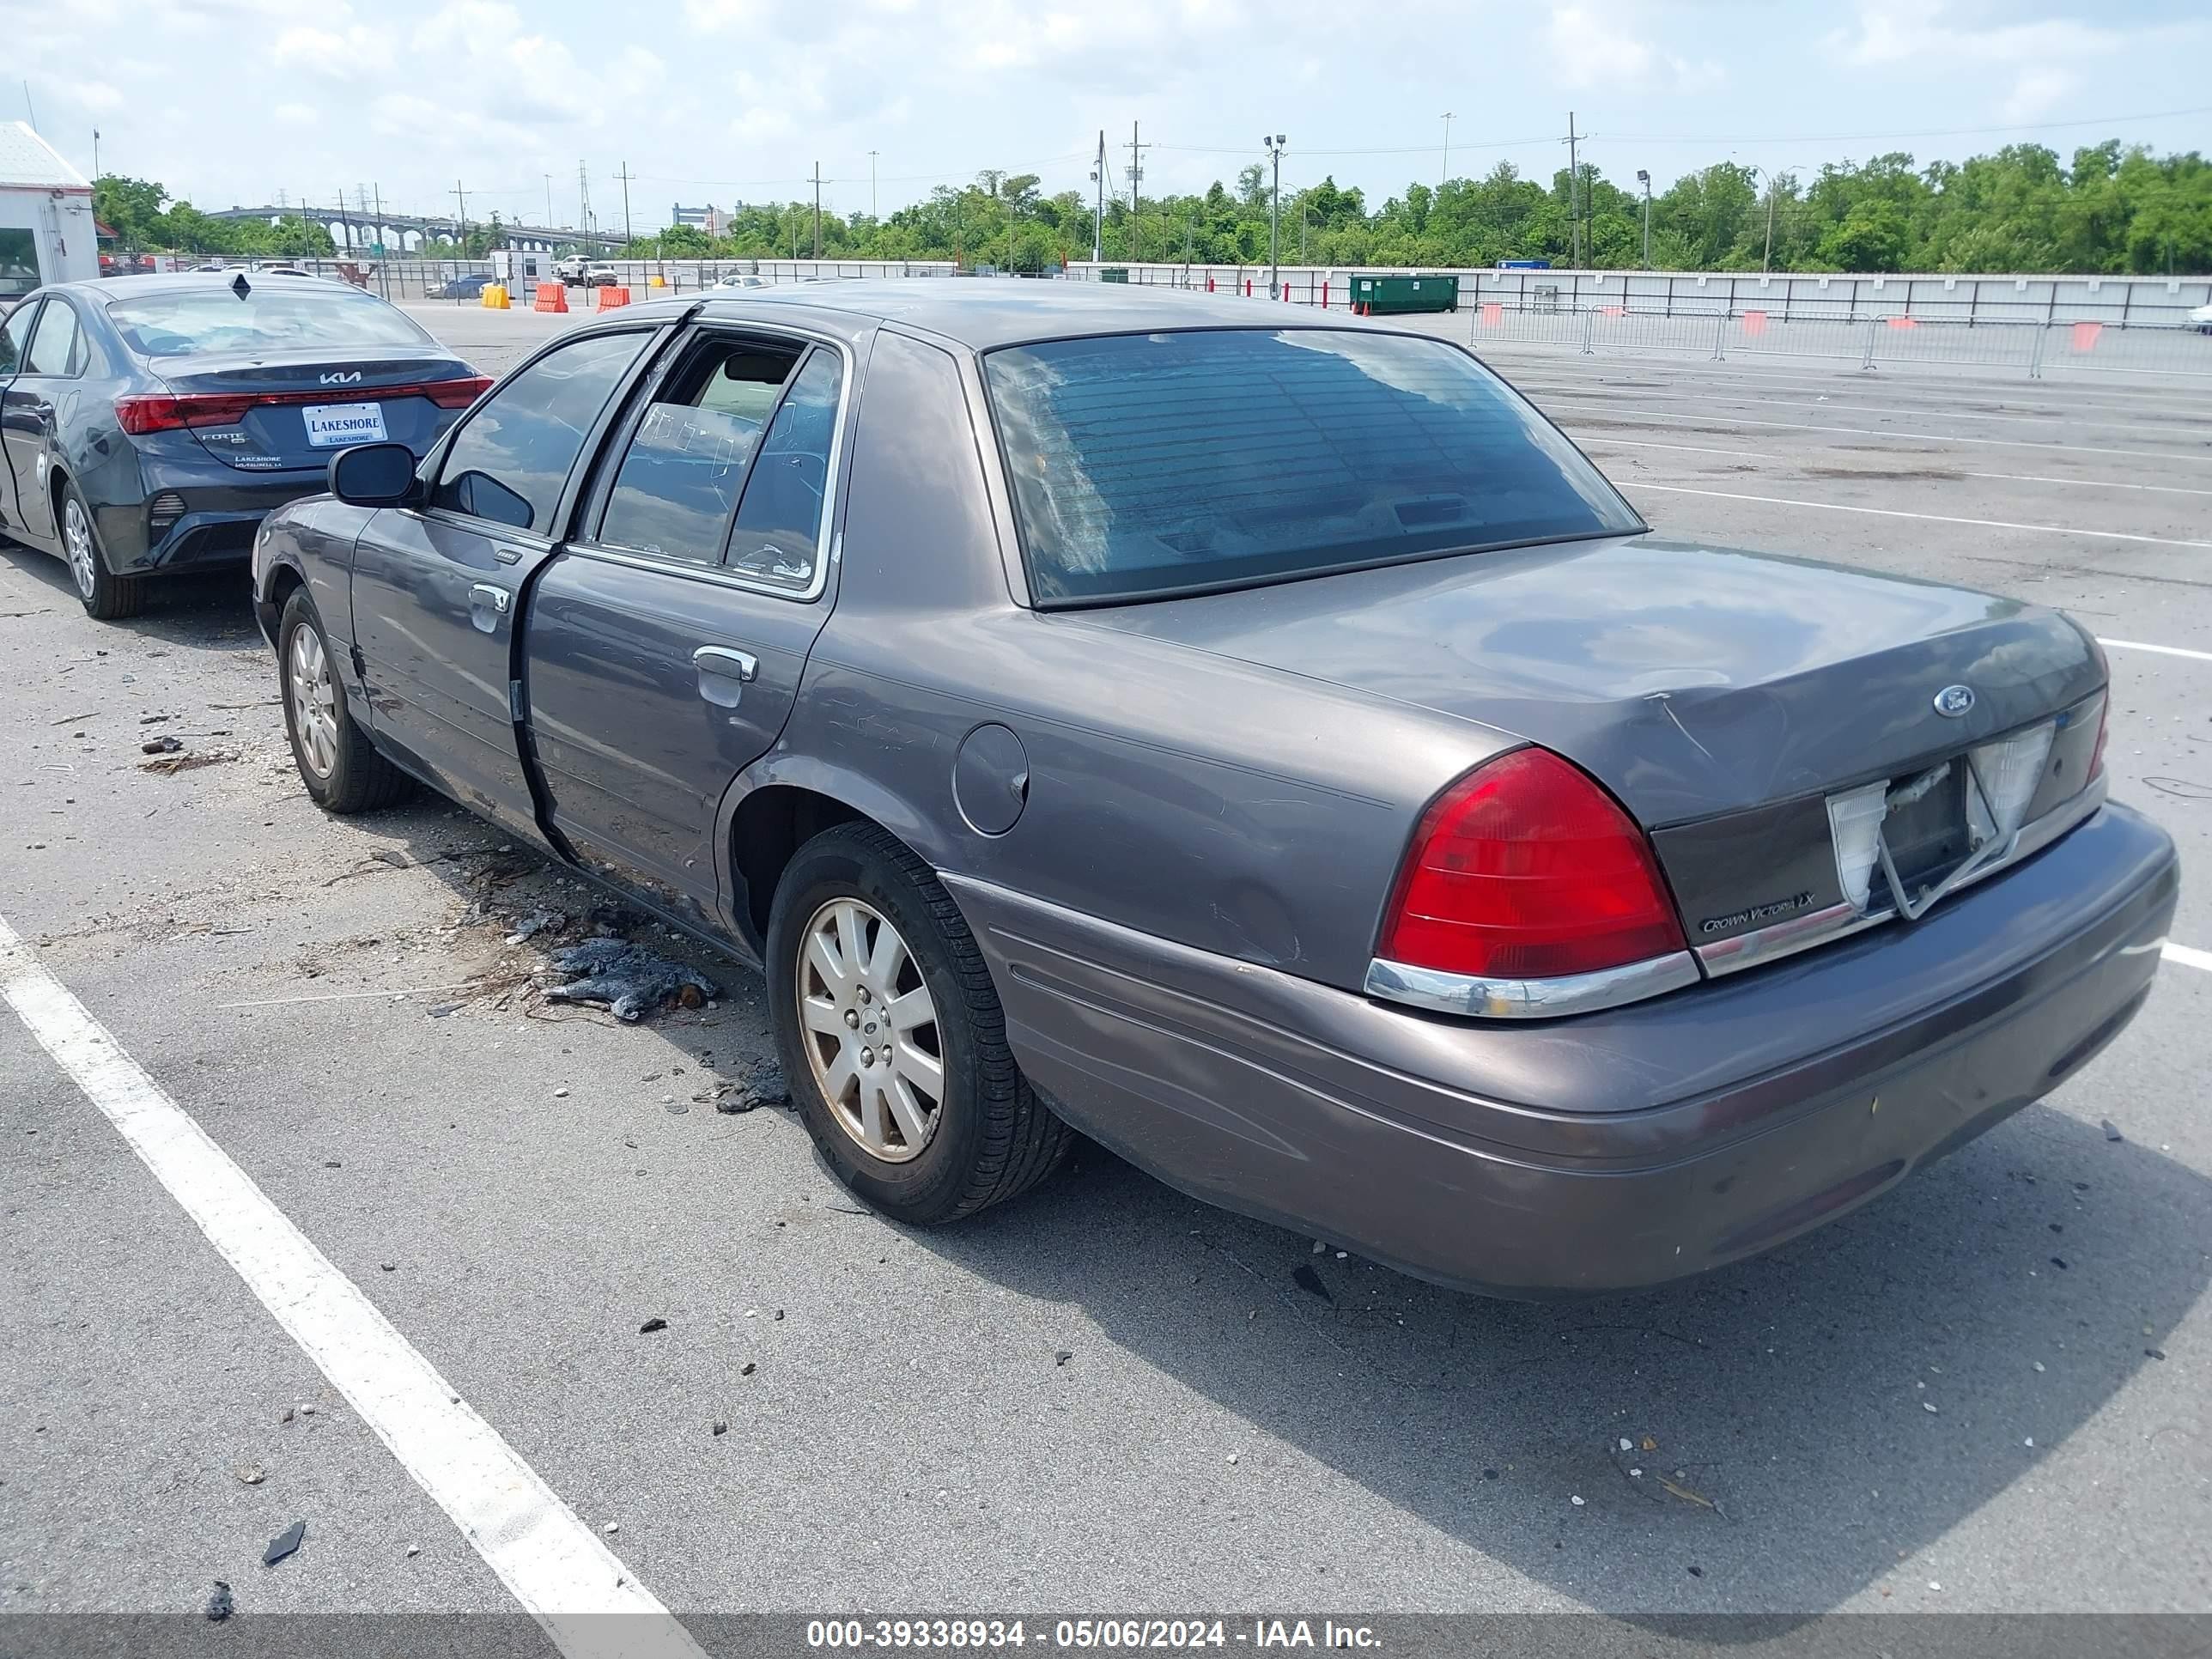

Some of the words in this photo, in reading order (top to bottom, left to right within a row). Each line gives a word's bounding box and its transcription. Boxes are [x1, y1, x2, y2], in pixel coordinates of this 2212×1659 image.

[319, 371, 362, 385] KIA
[311, 417, 380, 433] LAKESHORE
[203, 432, 245, 441] FORTE
[1798, 893, 1815, 908] LX
